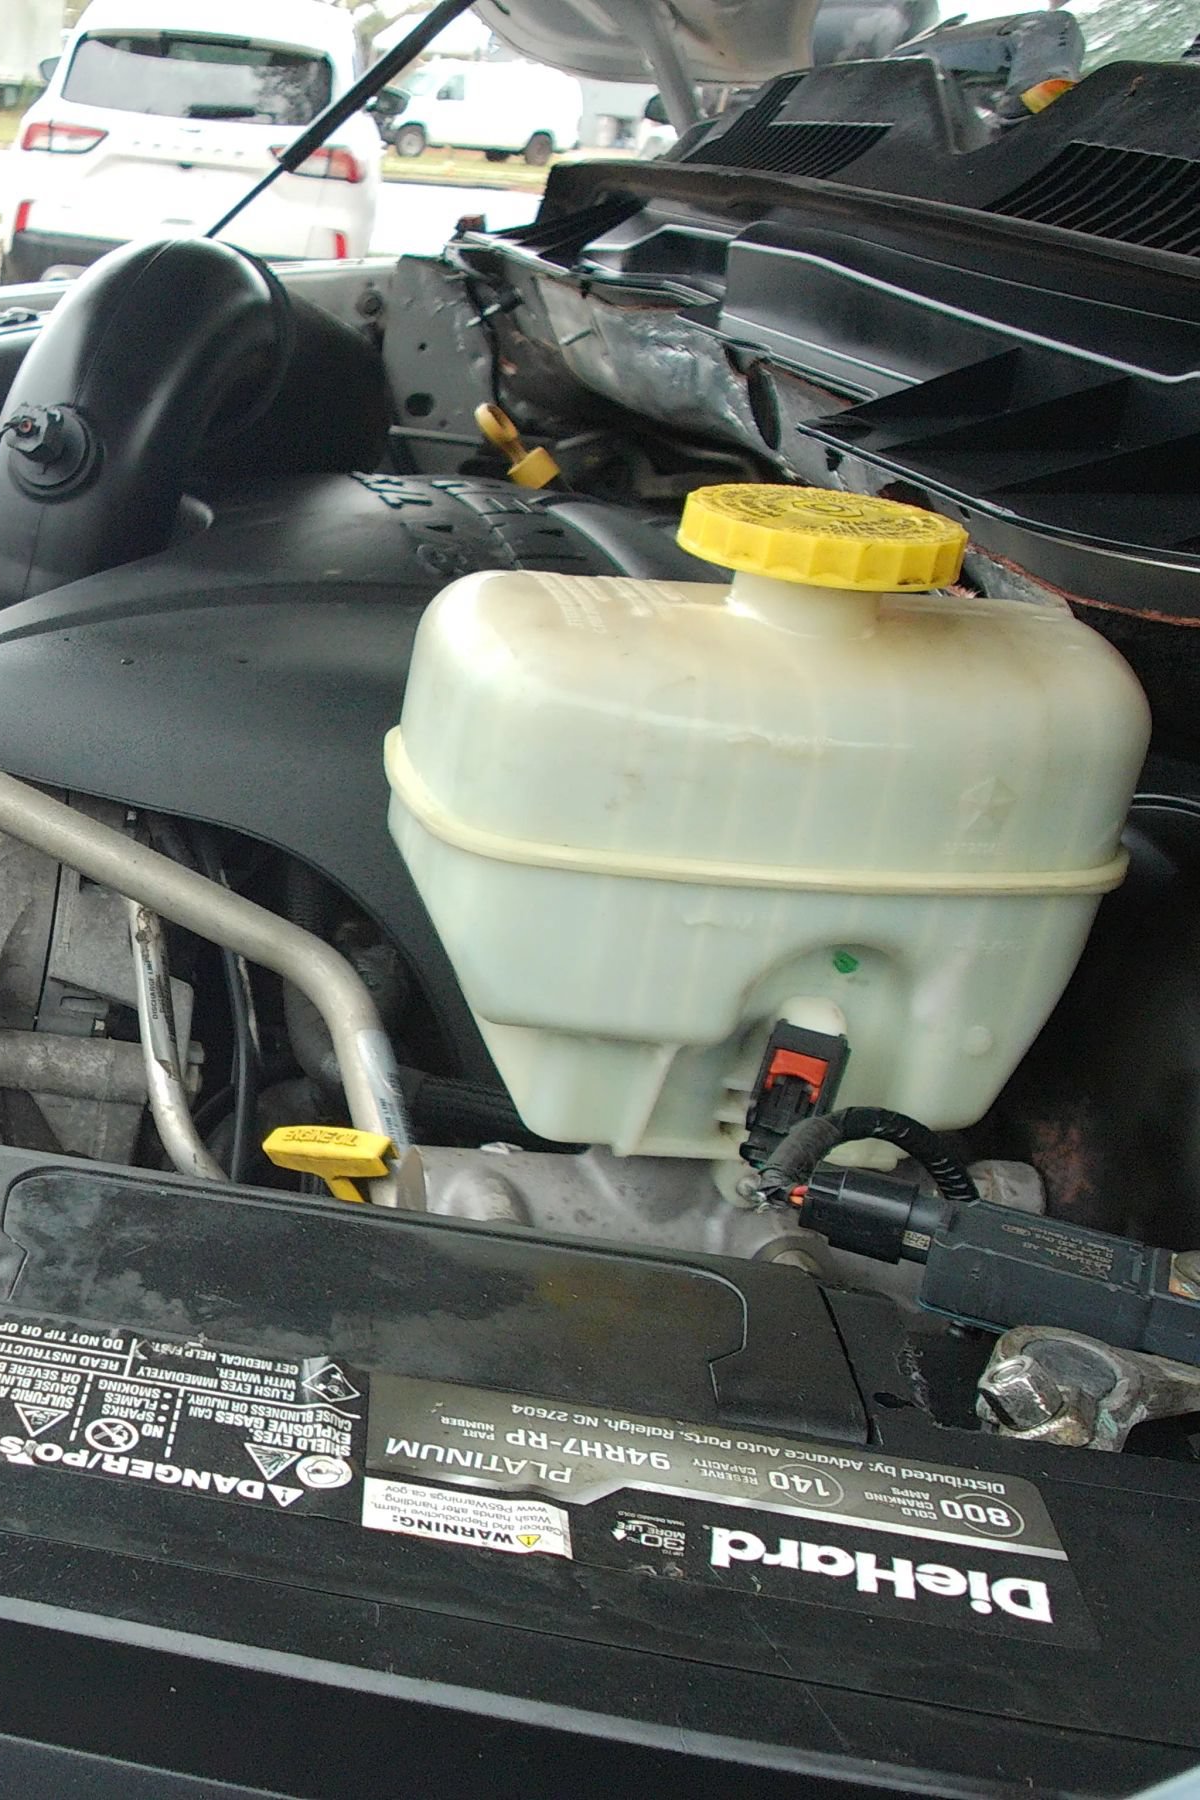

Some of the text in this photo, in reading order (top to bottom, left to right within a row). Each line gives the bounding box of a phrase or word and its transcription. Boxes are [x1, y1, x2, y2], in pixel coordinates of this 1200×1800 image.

[282, 1129, 334, 1144] ENGINE
[20, 1324, 42, 1338] OR
[44, 1327, 67, 1341] TIP
[68, 1332, 100, 1346] NOT
[101, 1336, 123, 1351] DO
[79, 1354, 120, 1371] READ
[184, 1347, 217, 1362] HELP
[217, 1351, 273, 1372] MEDICAL
[9, 1360, 61, 1381] SEVERE
[62, 1371, 81, 1384] OR
[215, 1366, 296, 1390] WITH WATER.
[274, 1361, 299, 1376] GET
[33, 1380, 78, 1396] CAUSE
[98, 1379, 162, 1399] SMOKING
[136, 1365, 295, 1402] FLUSH EYES IMMEDIATELY
[10, 1387, 75, 1409] SULFURIC
[103, 1391, 159, 1411] FLAMES
[100, 1403, 156, 1423] SPARKS
[186, 1392, 352, 1431] CAUSE BLINDNESS OR INJURY.
[510, 1403, 569, 1422] 27604
[573, 1413, 599, 1427] NC
[140, 1422, 165, 1438] NO
[188, 1405, 352, 1444] EXPLOSIVE GASES CAN
[439, 1414, 495, 1432] NUMBER
[248, 1427, 351, 1457] SHIELD EYES.
[462, 1427, 495, 1442] PART
[504, 1427, 670, 1470] 94RH7-RP
[736, 1440, 780, 1458] Auto
[384, 1437, 573, 1484] PLATINUM
[692, 1457, 757, 1476] CAPACITY
[784, 1448, 863, 1472] Advance
[868, 1460, 896, 1479] by:
[698, 1467, 758, 1486] RESERVE
[767, 1471, 830, 1498] 140
[900, 1466, 1005, 1495] Distributed
[864, 1490, 935, 1511] CRANKING
[890, 1486, 930, 1501] AMPS
[381, 1493, 552, 1525] Wash hands after handling.
[901, 1506, 938, 1522] COLD
[938, 1498, 1012, 1530] 800
[370, 1501, 563, 1537] Cancer and Reproductive Harm.
[391, 1513, 515, 1546] WARNING:
[615, 1520, 685, 1539] MORE LIFE
[710, 1526, 1053, 1624] DieHard
